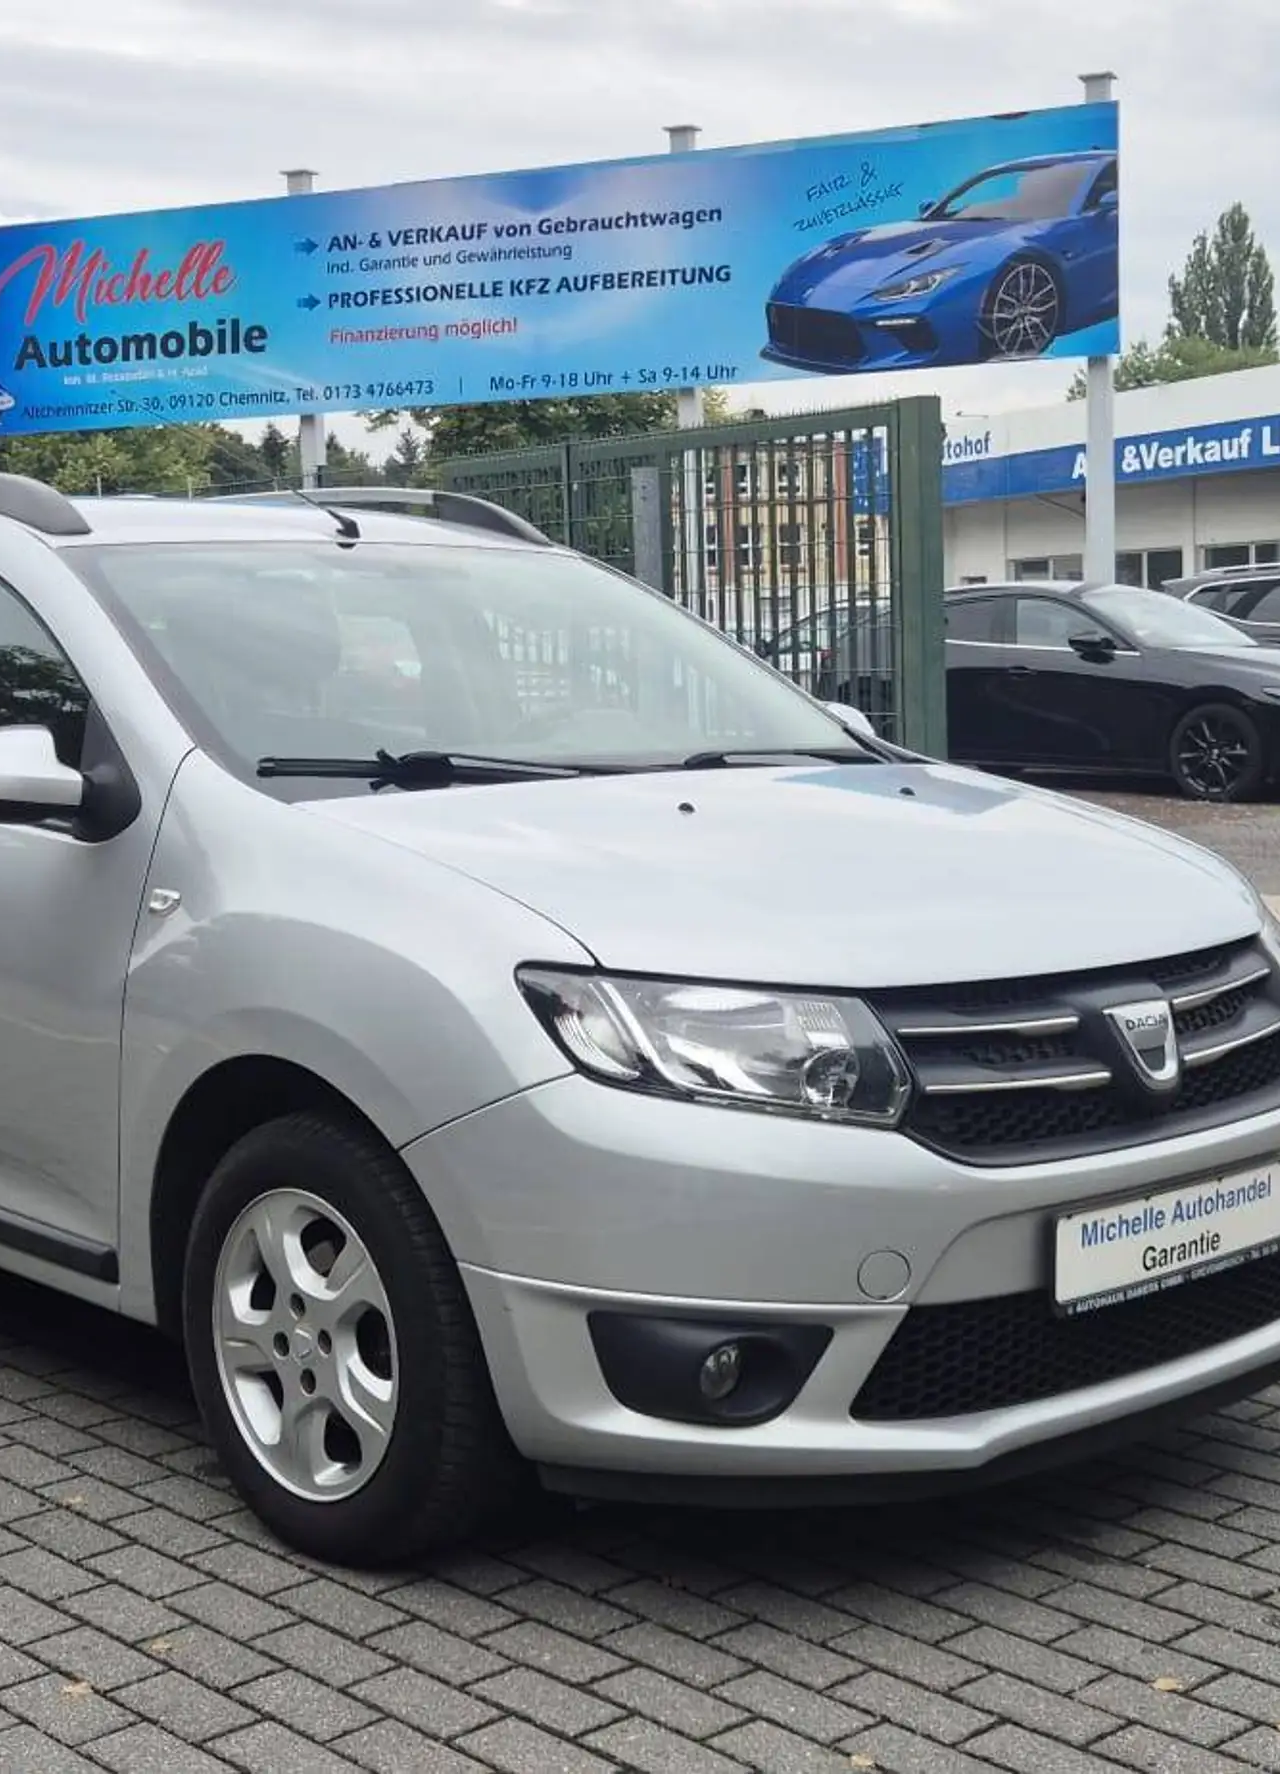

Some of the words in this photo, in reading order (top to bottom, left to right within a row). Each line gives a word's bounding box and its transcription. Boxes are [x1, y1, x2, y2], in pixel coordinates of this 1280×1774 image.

[860, 160, 878, 189] &
[327, 234, 363, 253] AN-
[369, 231, 382, 249] &
[387, 222, 488, 247] VERKAUF
[494, 222, 532, 238] von
[538, 207, 722, 236] Gebrauchtwagen
[359, 255, 419, 273] Garantie
[423, 251, 452, 266] und
[456, 244, 573, 264] Gewährleistung
[328, 282, 503, 309] PROFESSIONELLE
[510, 277, 550, 297] KFZ
[556, 264, 732, 294] AUFBEREITUNG
[14, 318, 269, 370] Automobile
[330, 323, 440, 344] Finanzierung
[445, 317, 518, 339] möglich!
[117, 398, 139, 414] Str.
[142, 396, 164, 412] 30,
[170, 392, 214, 410] 09120
[220, 388, 290, 407] Chemnitz,
[295, 386, 319, 402] Tel.
[323, 383, 362, 401] 0173
[366, 379, 434, 399] 4766473
[490, 374, 537, 392] Mo-Fr
[541, 372, 578, 389] 9-18
[584, 371, 614, 386] Uhr
[621, 373, 631, 383] +
[638, 367, 657, 384] Sa
[662, 364, 700, 382] 9-14
[706, 363, 738, 381] Uhr
[1121, 432, 1252, 474] &Verkauf
[1080, 1202, 1166, 1249] Michelle
[1171, 1174, 1271, 1223] Autohandel
[1142, 1231, 1220, 1272] Garantie
